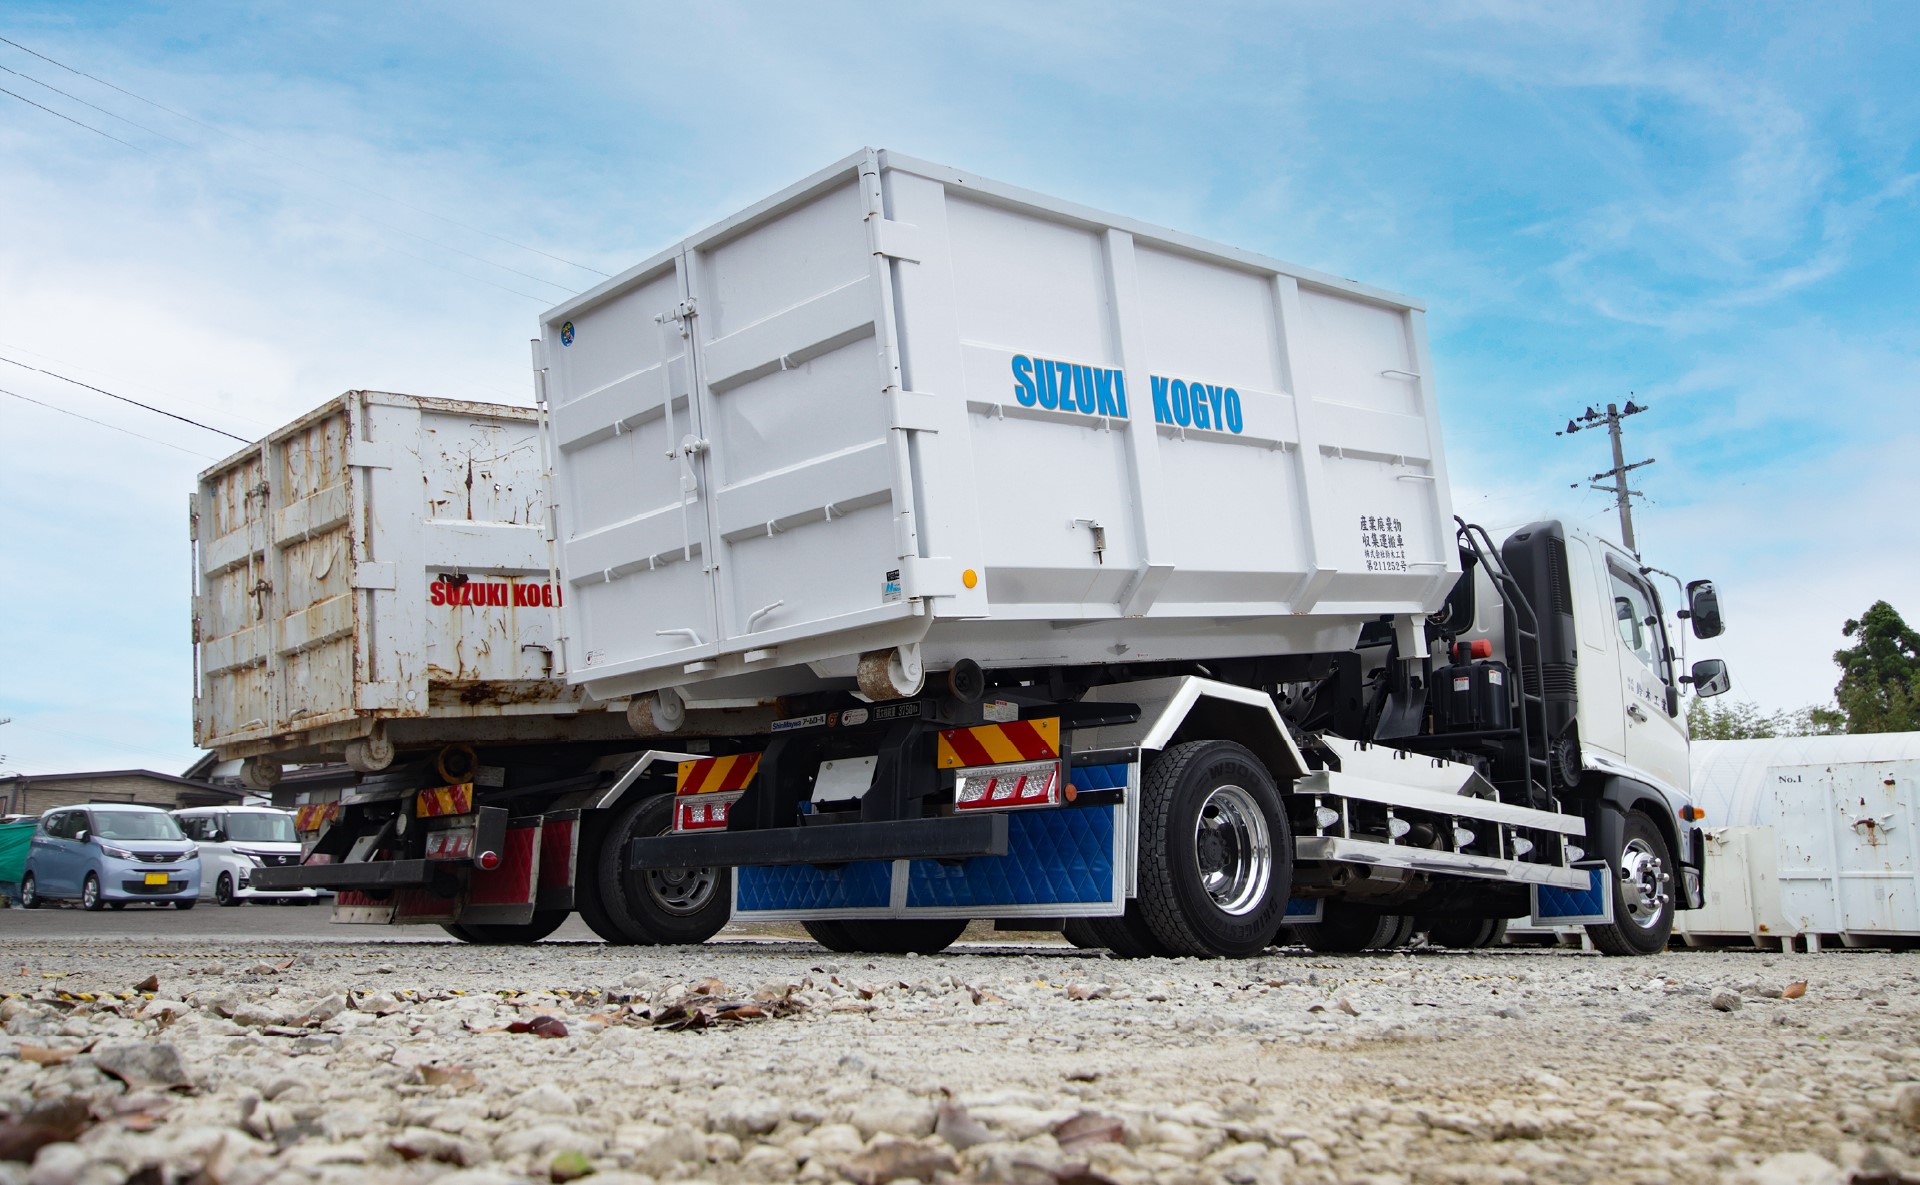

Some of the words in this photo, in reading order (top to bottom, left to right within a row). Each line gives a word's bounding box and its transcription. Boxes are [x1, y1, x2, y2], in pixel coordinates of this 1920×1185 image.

[1011, 353, 1128, 419] SUZUKI
[1149, 375, 1243, 434] KOGYO
[1366, 560, 1407, 572] 第211252号
[430, 581, 508, 607] SUZUKI
[1778, 774, 1802, 784] No.1
